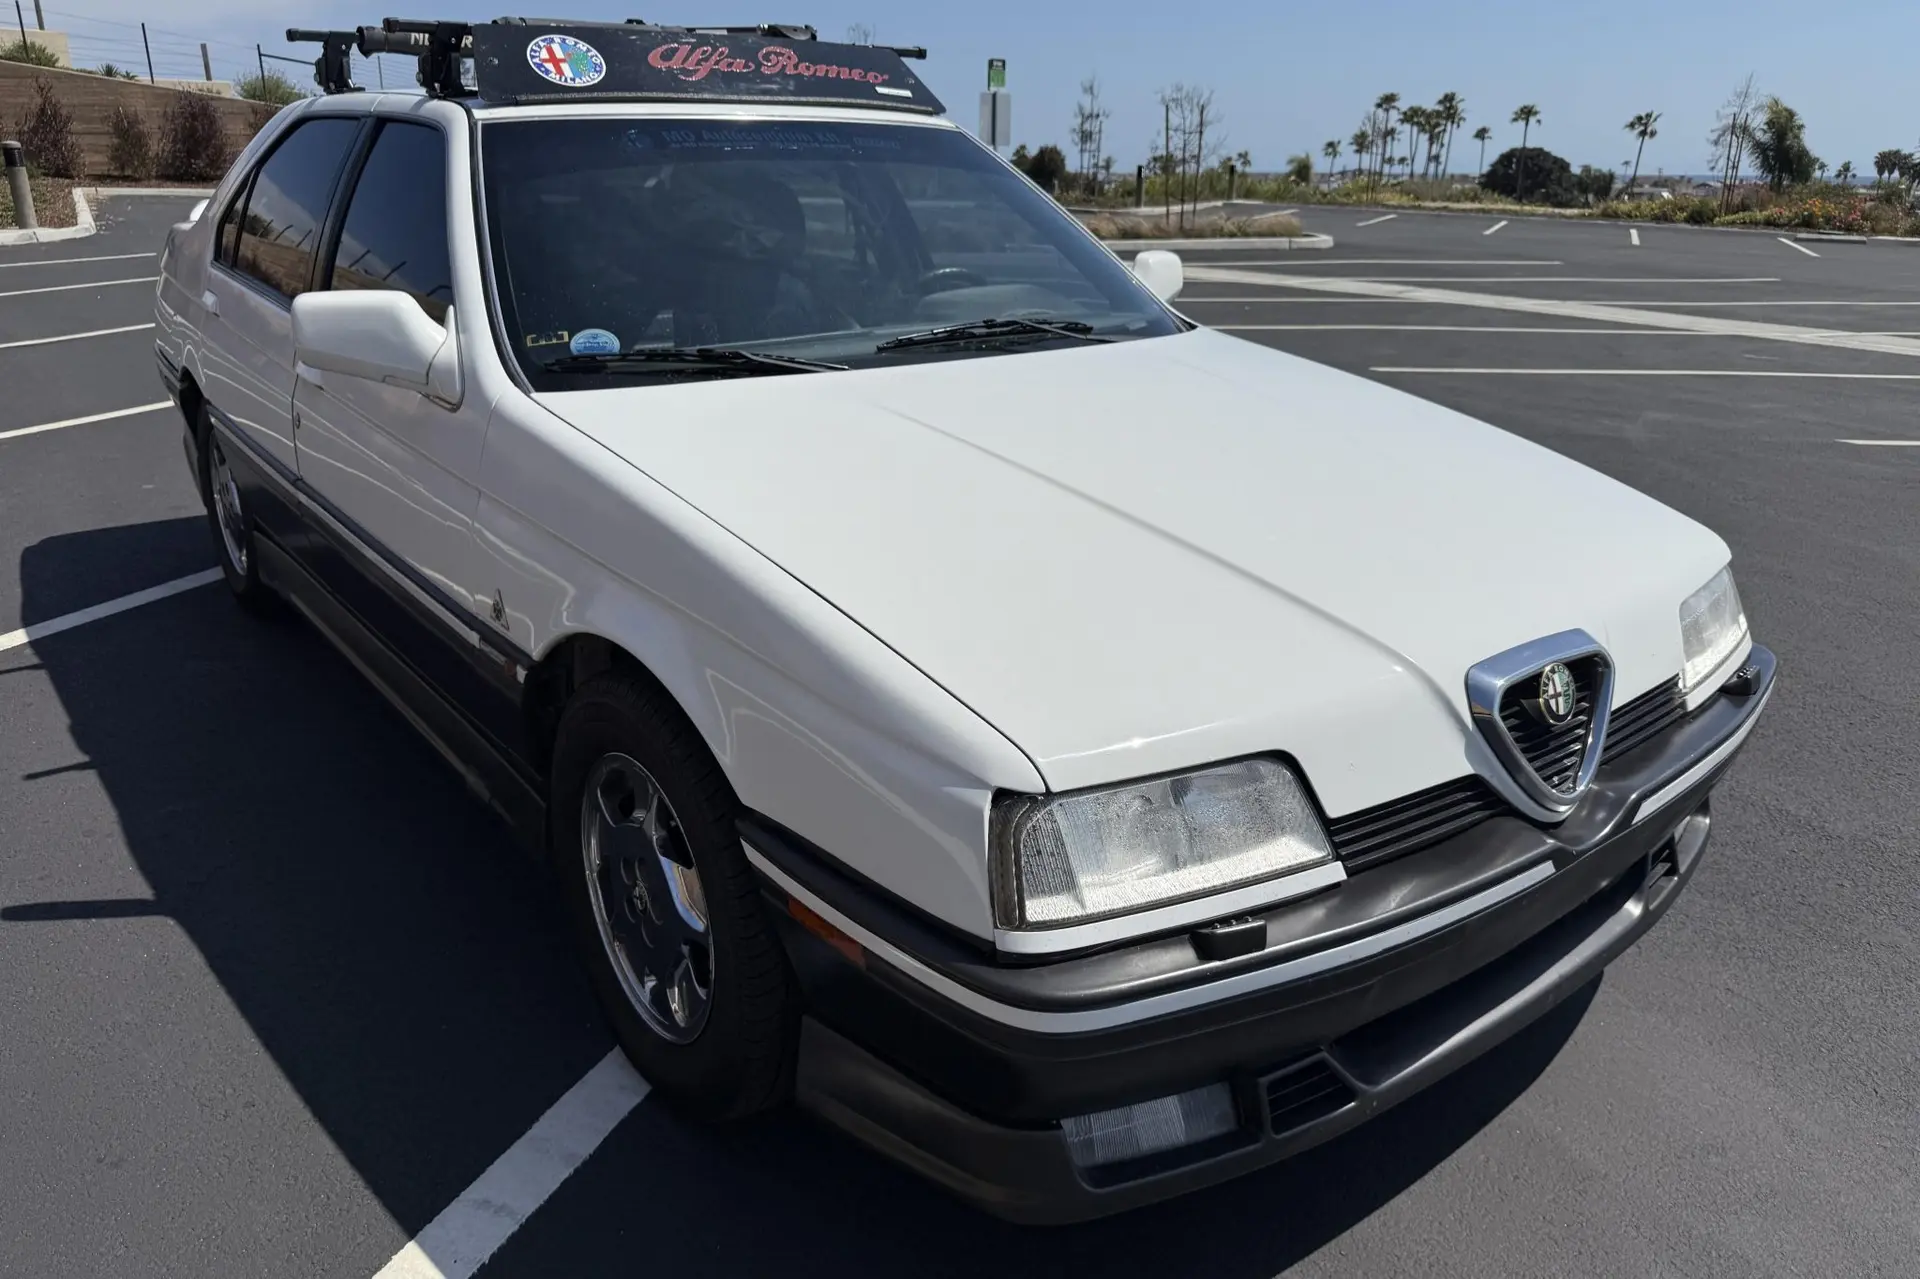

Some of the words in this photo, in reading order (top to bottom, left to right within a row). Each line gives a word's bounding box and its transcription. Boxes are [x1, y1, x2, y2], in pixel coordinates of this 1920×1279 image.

[530, 40, 546, 63] ALFA
[553, 36, 601, 64] ROMEO
[647, 43, 756, 81] Alfa
[757, 46, 888, 84] Romeo
[548, 72, 599, 85] MILANO
